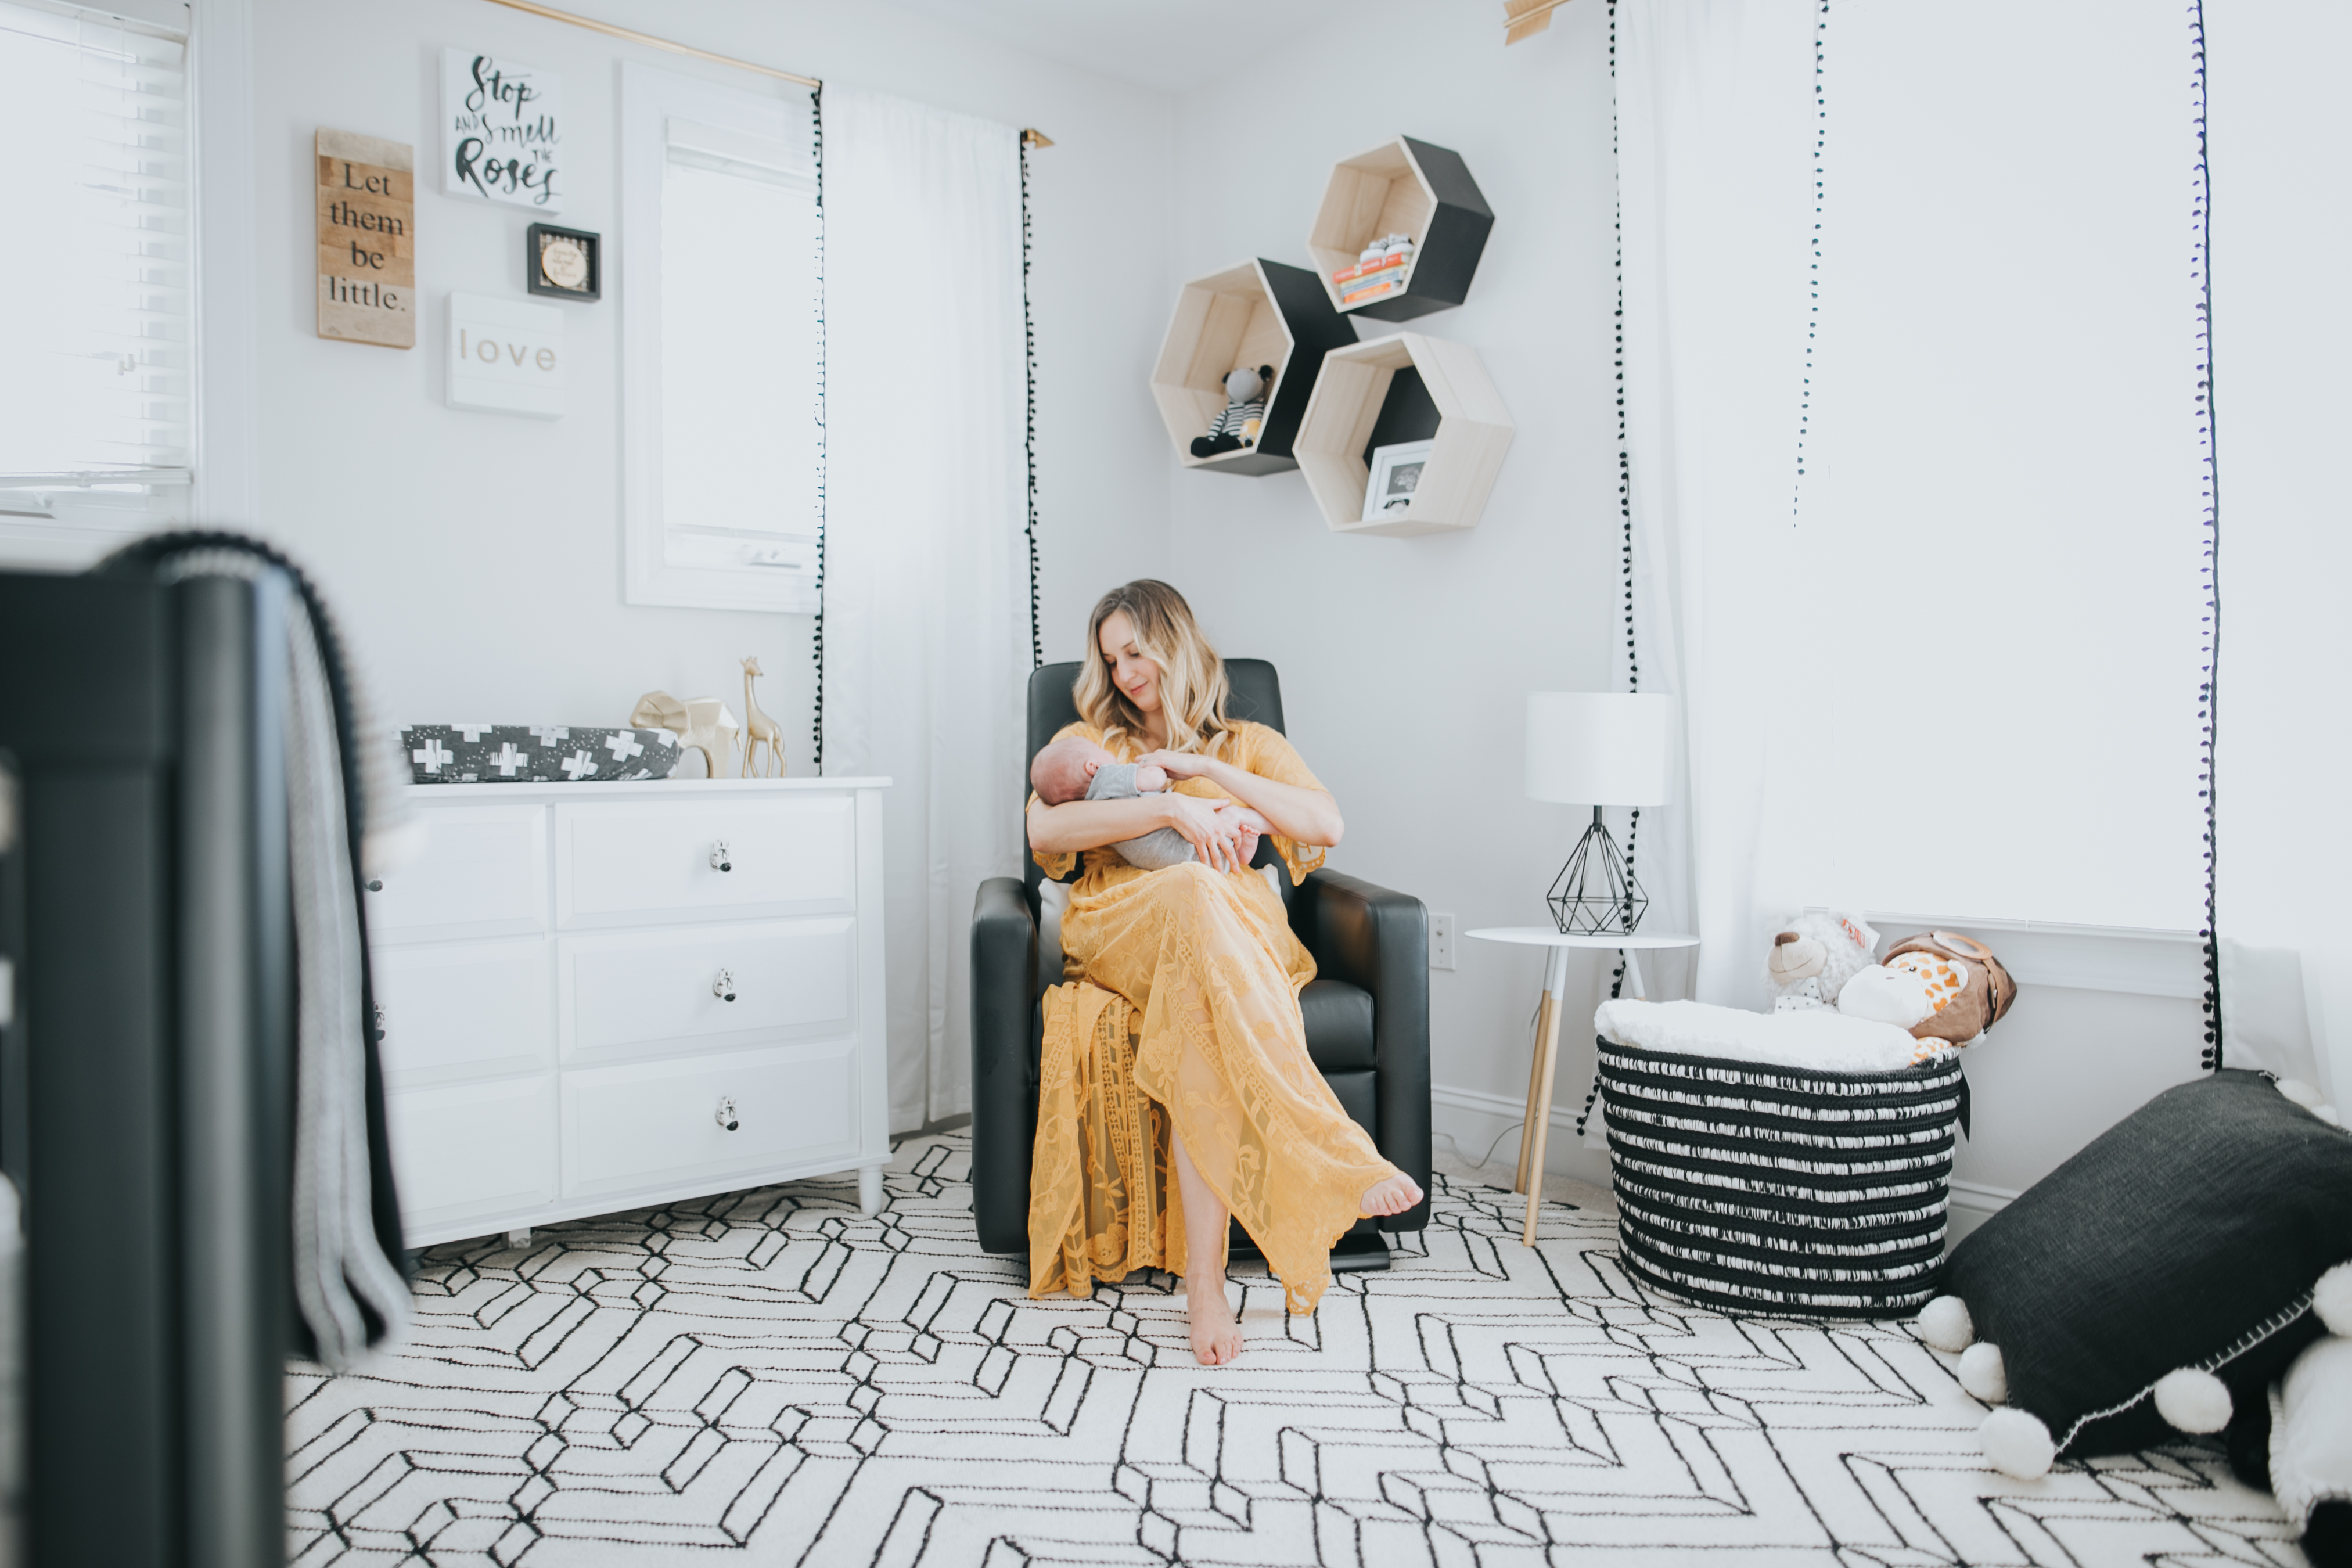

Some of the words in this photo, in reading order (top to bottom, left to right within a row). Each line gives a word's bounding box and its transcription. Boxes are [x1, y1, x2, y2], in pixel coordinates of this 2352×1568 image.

[465, 55, 542, 120] Stop
[456, 114, 479, 134] AND
[456, 138, 562, 205] Roses
[531, 148, 552, 163] THE
[343, 163, 391, 196] Let
[330, 201, 403, 236] them
[351, 240, 384, 269] be
[330, 276, 405, 311] little.
[461, 329, 556, 371] love
